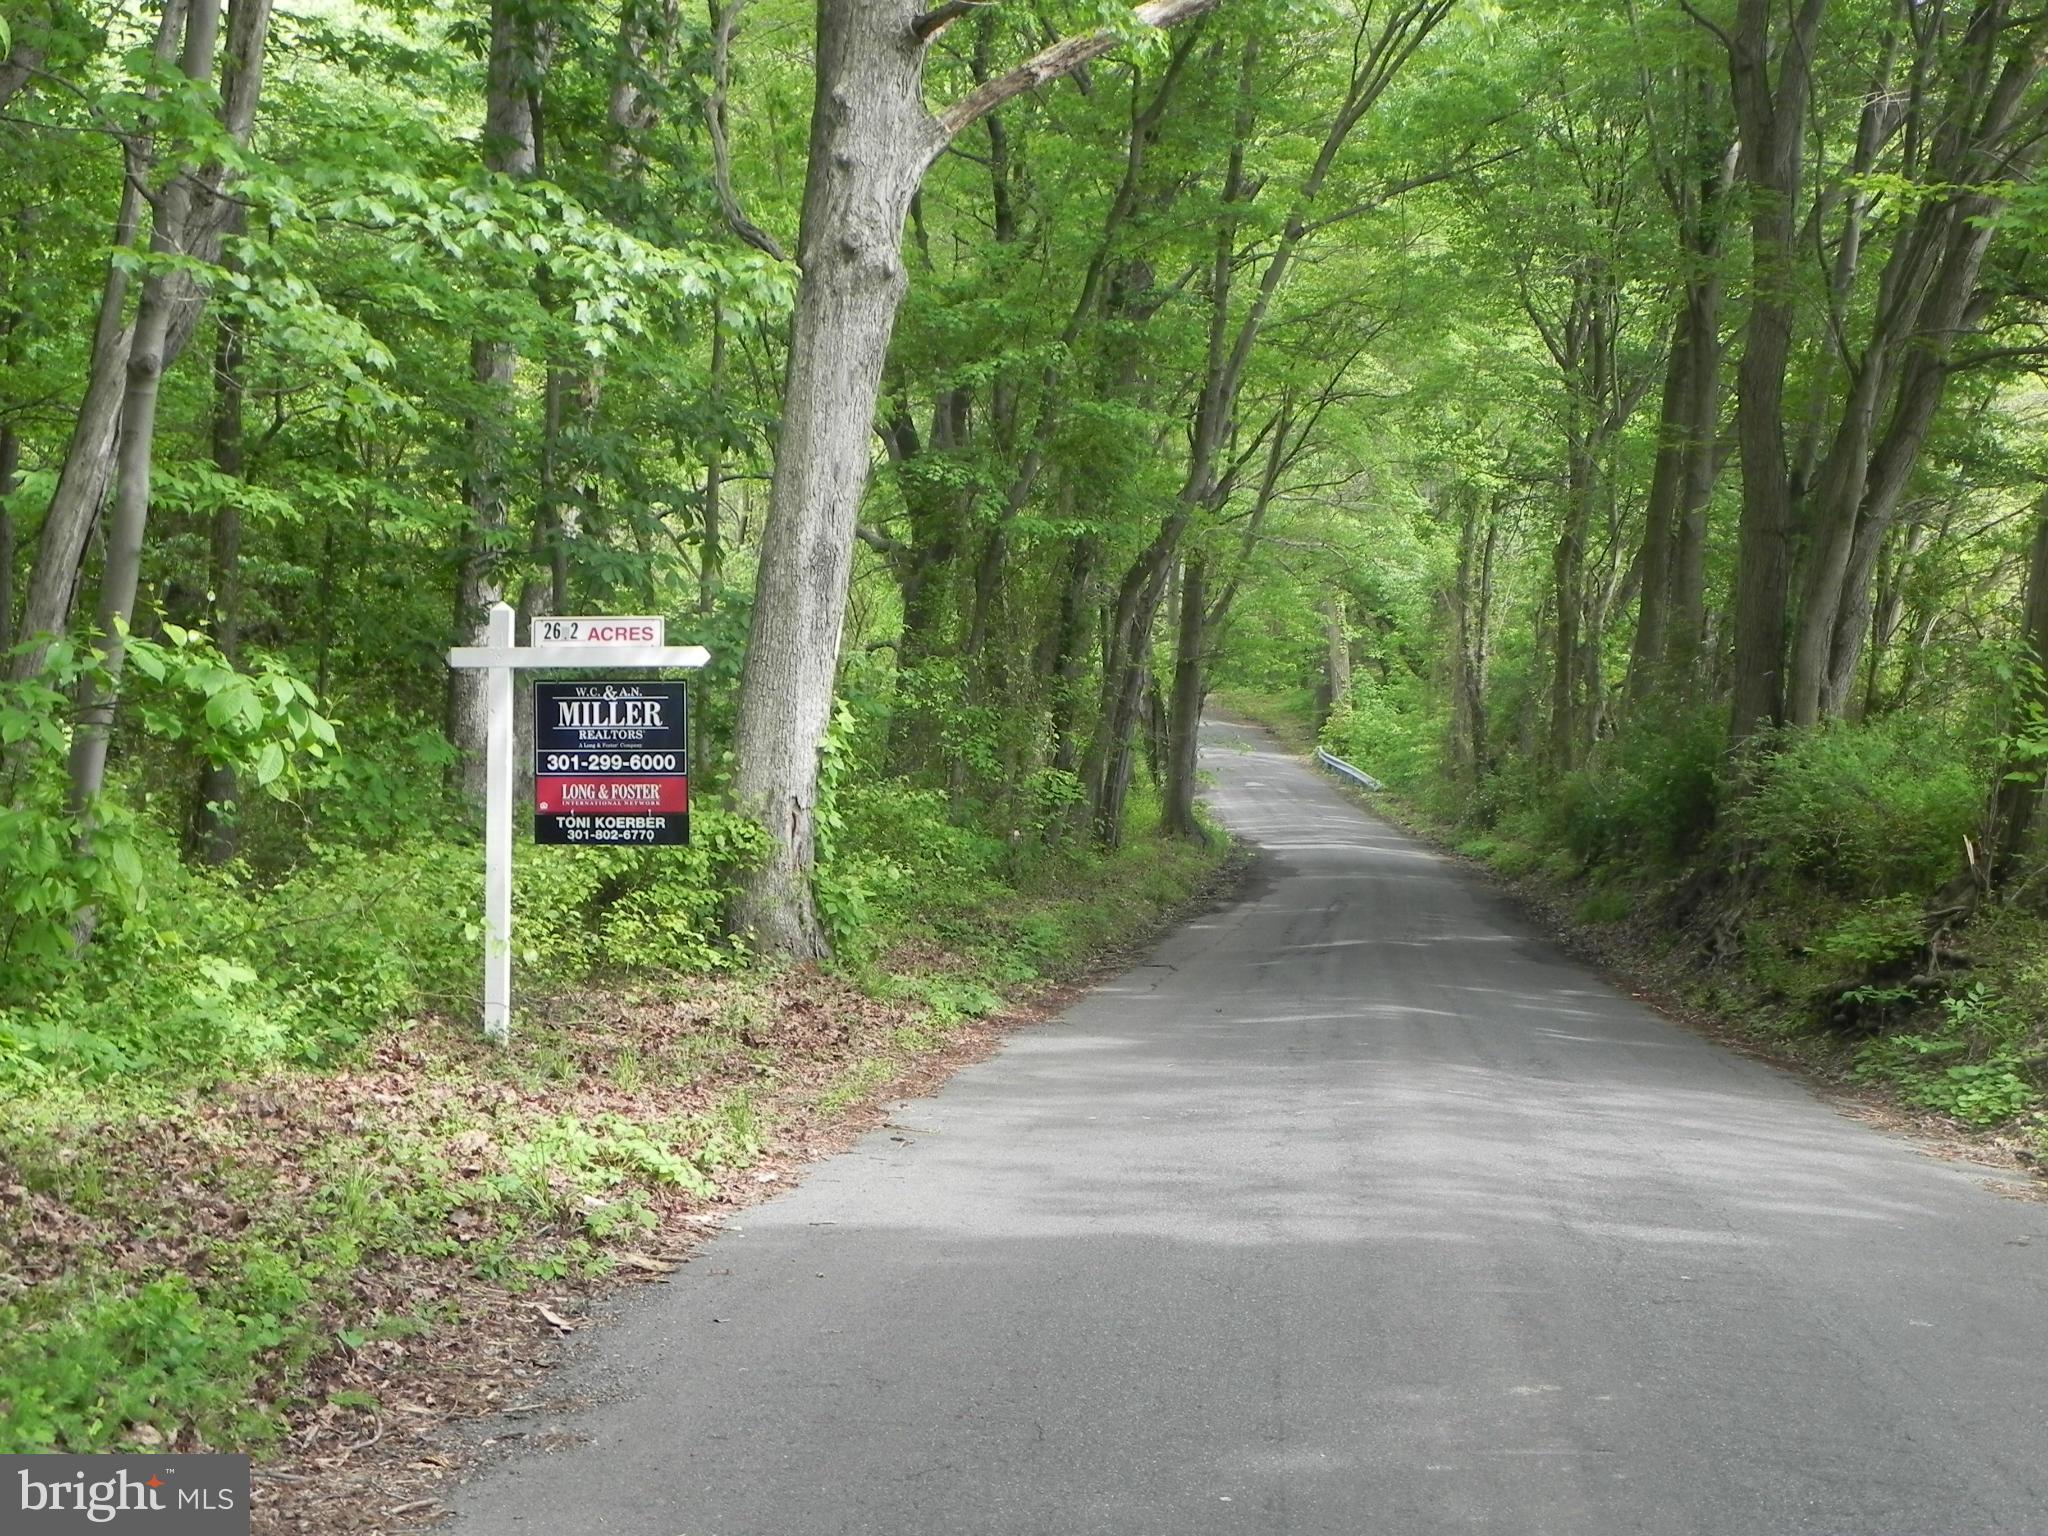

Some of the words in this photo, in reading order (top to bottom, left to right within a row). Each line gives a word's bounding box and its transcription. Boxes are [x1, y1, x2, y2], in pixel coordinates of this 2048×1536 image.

[587, 626, 654, 641] ACRES
[575, 687, 600, 697] W.C.
[603, 685, 618, 701] &
[619, 687, 643, 697] A.N.
[558, 701, 663, 727] MILLER
[546, 754, 676, 771] 301-299-6000
[562, 783, 595, 800] LONG
[598, 783, 609, 800] &
[611, 783, 660, 800] FOSTER
[556, 816, 591, 829] TONI
[595, 816, 666, 829] KOERBER
[567, 829, 655, 841] 301-802-6770
